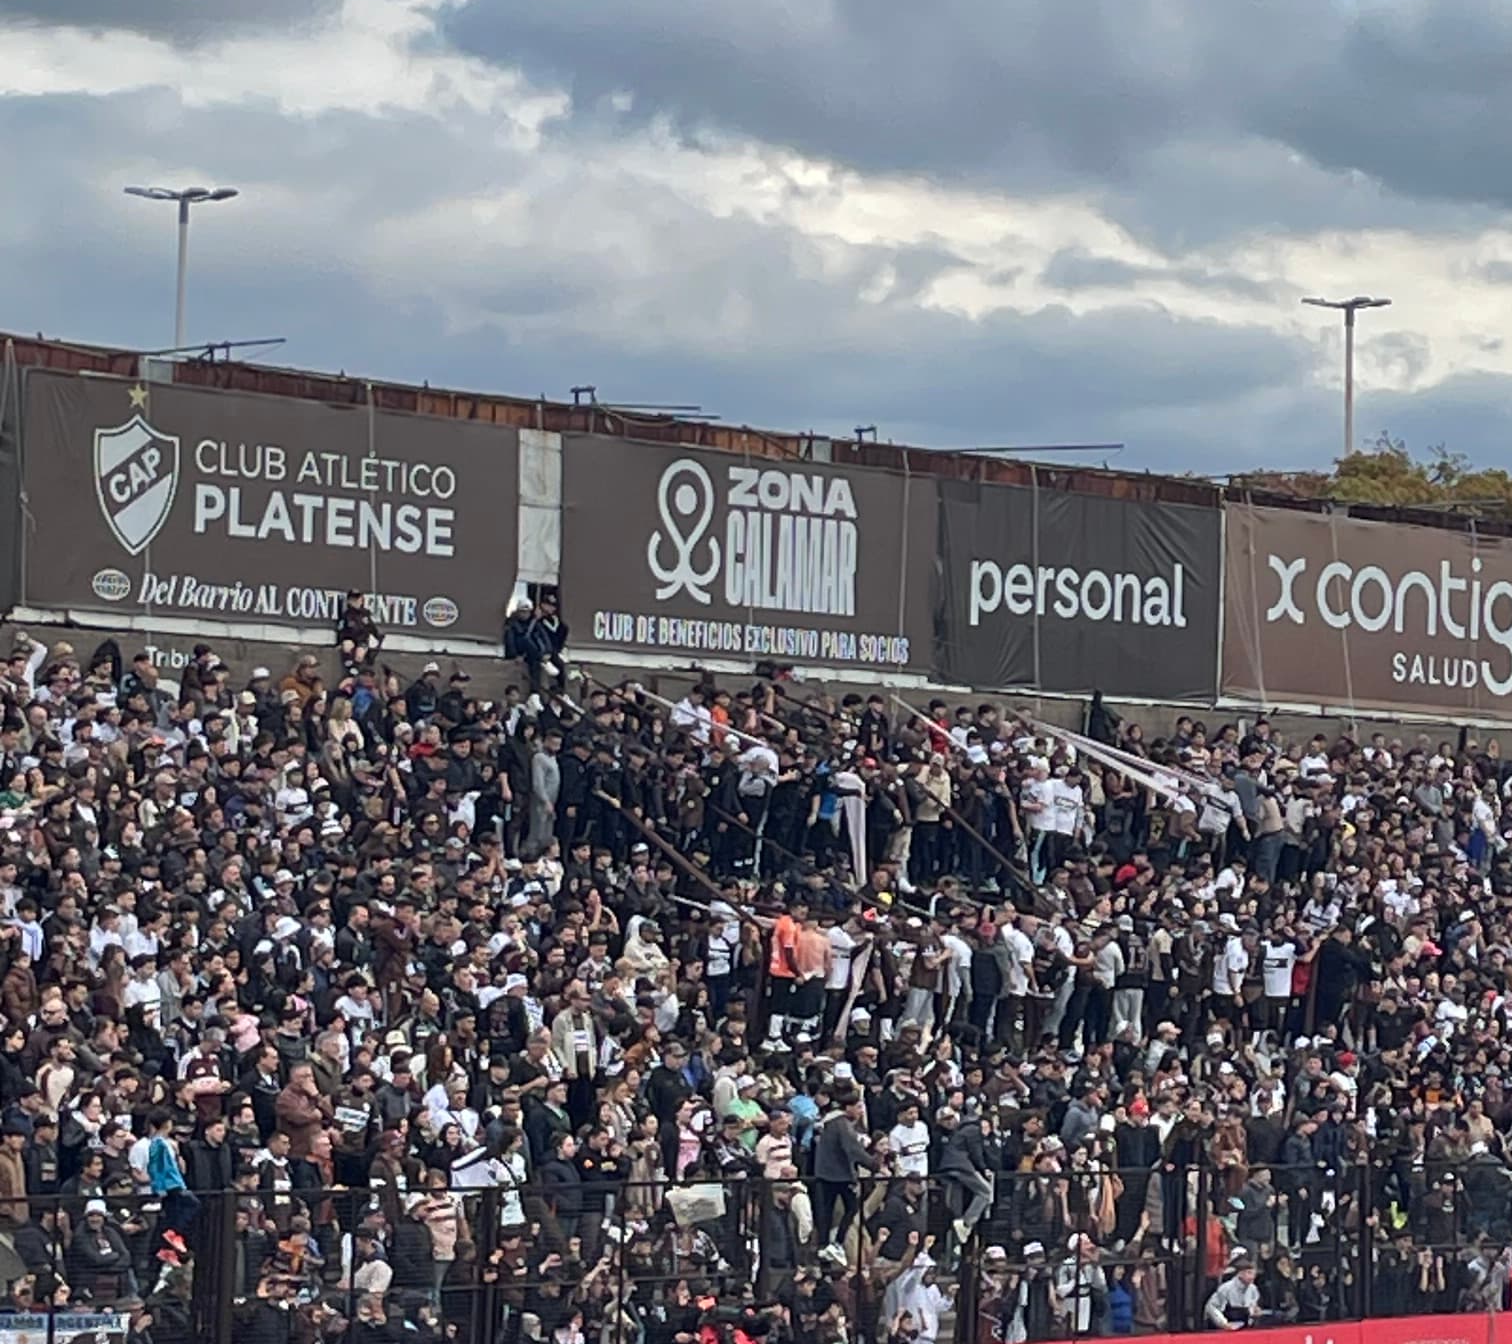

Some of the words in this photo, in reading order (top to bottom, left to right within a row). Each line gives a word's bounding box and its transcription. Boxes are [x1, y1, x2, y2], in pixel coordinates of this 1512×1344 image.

[108, 446, 162, 504] CAP
[194, 439, 288, 481] CLUB
[297, 449, 457, 500] ATLÉTICO
[726, 465, 859, 520] ZONA
[193, 484, 456, 558] PLATENSE
[725, 510, 858, 618] CALAMAR
[969, 557, 1187, 629] personal
[137, 571, 178, 606] Del
[177, 575, 254, 613] Barrio
[253, 585, 284, 616] AL
[285, 586, 418, 627] CONTENTE
[593, 611, 635, 642] CLUB
[636, 615, 656, 645] DE
[659, 617, 742, 651] BENEFICIOS
[745, 625, 818, 658] EXCLUSIVO
[820, 630, 856, 661] PARA
[859, 633, 911, 665] SOCIOS
[1391, 651, 1479, 689] SALUD
